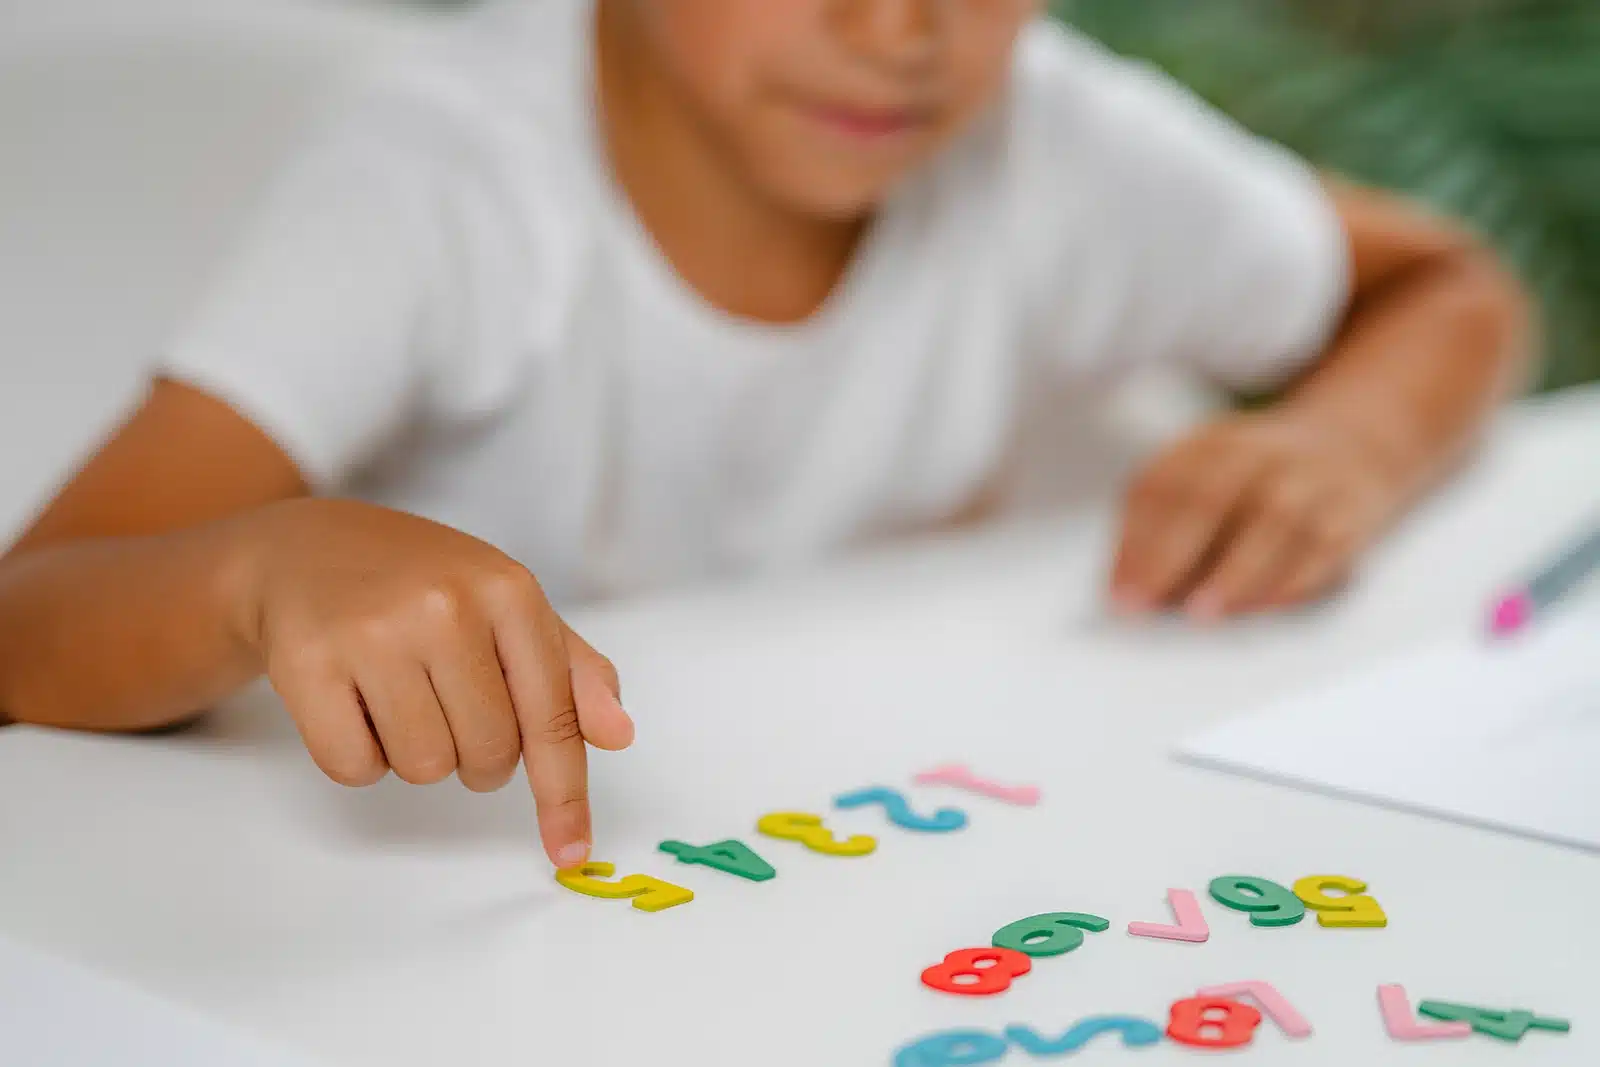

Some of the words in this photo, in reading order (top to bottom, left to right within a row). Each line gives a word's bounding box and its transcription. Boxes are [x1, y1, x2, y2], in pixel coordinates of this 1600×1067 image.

[757, 812, 877, 857] 3
[835, 787, 967, 833] 2
[658, 839, 777, 882] 4
[556, 861, 694, 912] 5
[1293, 875, 1387, 928] 5
[921, 947, 1031, 996] 8
[1166, 997, 1261, 1048] 8
